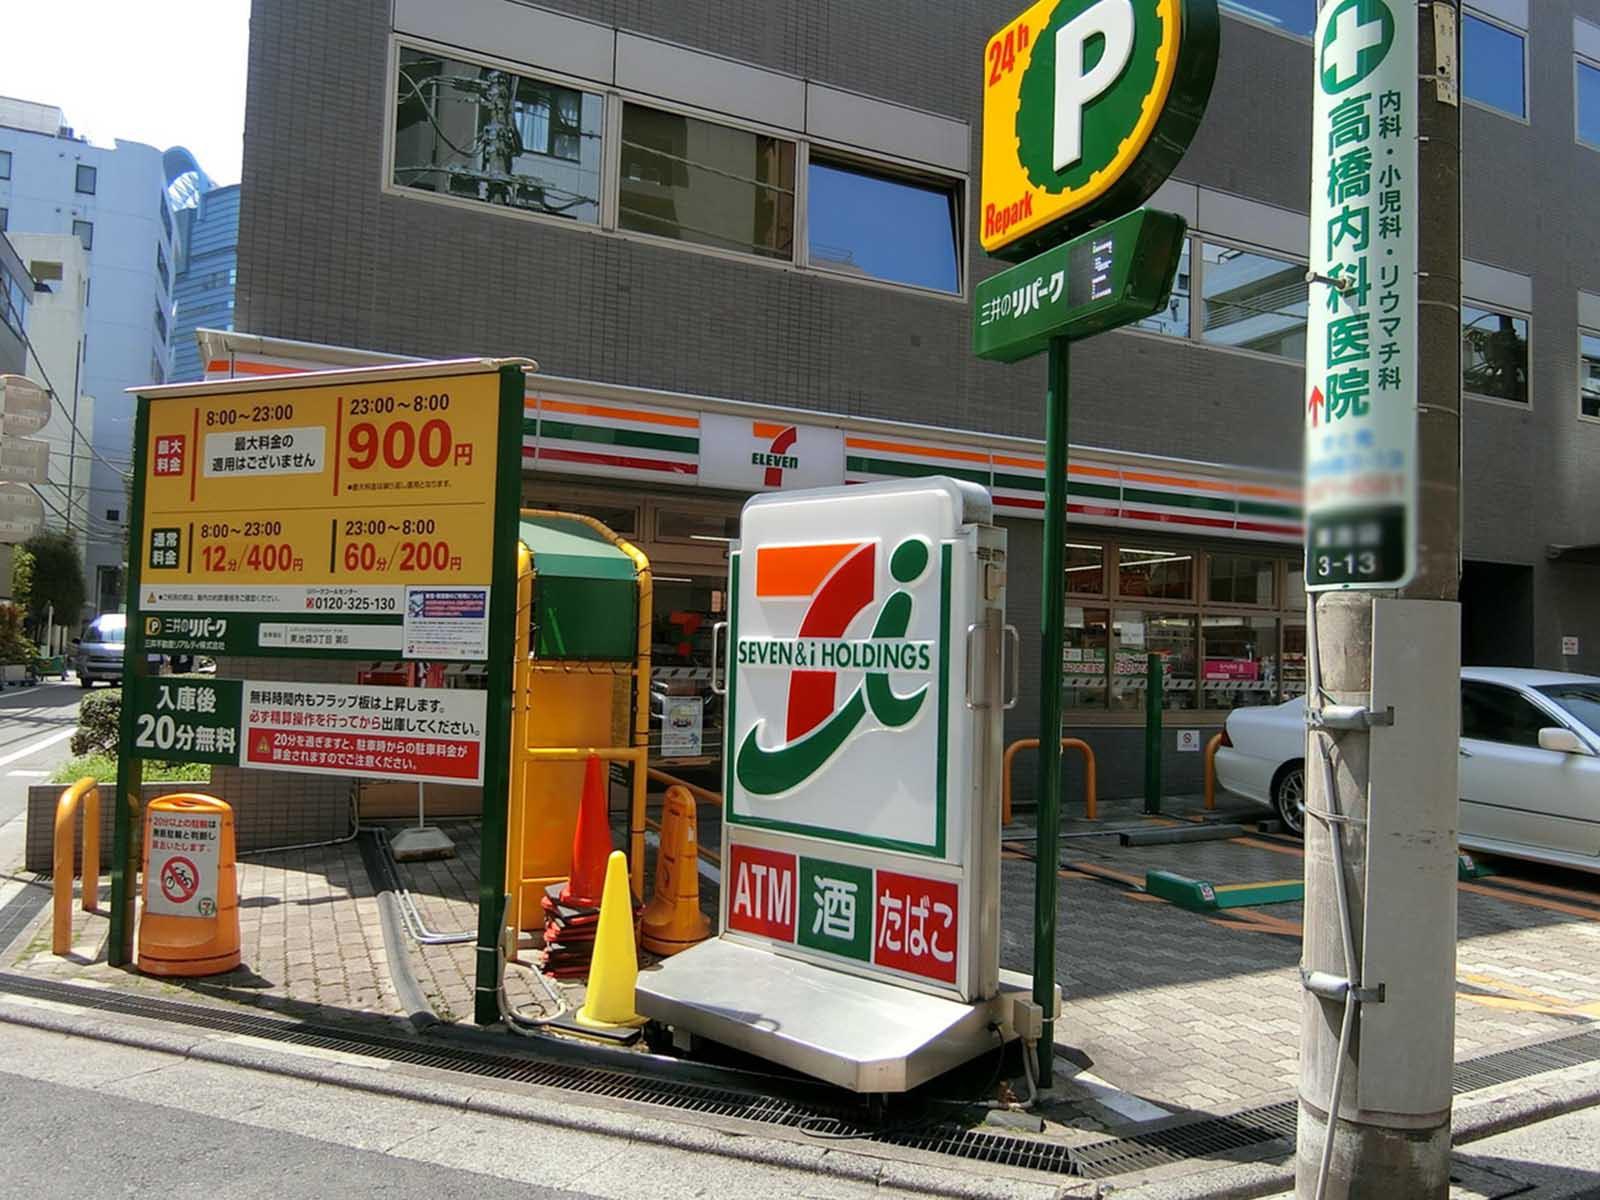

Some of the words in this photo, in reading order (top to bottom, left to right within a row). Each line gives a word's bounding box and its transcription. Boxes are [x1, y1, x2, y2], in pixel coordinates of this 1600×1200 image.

[988, 23, 1029, 88] 24h
[1053, 0, 1135, 172] P
[984, 190, 1033, 239] Repark
[1325, 92, 1372, 424] 高橋内科医院
[1377, 89, 1402, 391] 内科・小児科・リウマチ科
[980, 270, 1065, 326] 三井のリパーク
[156, 457, 182, 473] 料金
[157, 439, 184, 455] 最大
[212, 452, 316, 472] 適用はございません
[234, 434, 294, 452] 最大料金の
[347, 418, 474, 470] 900円
[152, 550, 177, 565] 料金
[1317, 552, 1377, 577] 3-13
[165, 617, 227, 637] 三井のリパーク
[156, 685, 217, 714] 入庫後
[250, 690, 445, 714] 無料時間内もフラップ板は上昇します。
[136, 714, 236, 754] 20分無料
[733, 862, 792, 926] ATM
[812, 875, 858, 941] 酒
[879, 888, 954, 963] たばこ
